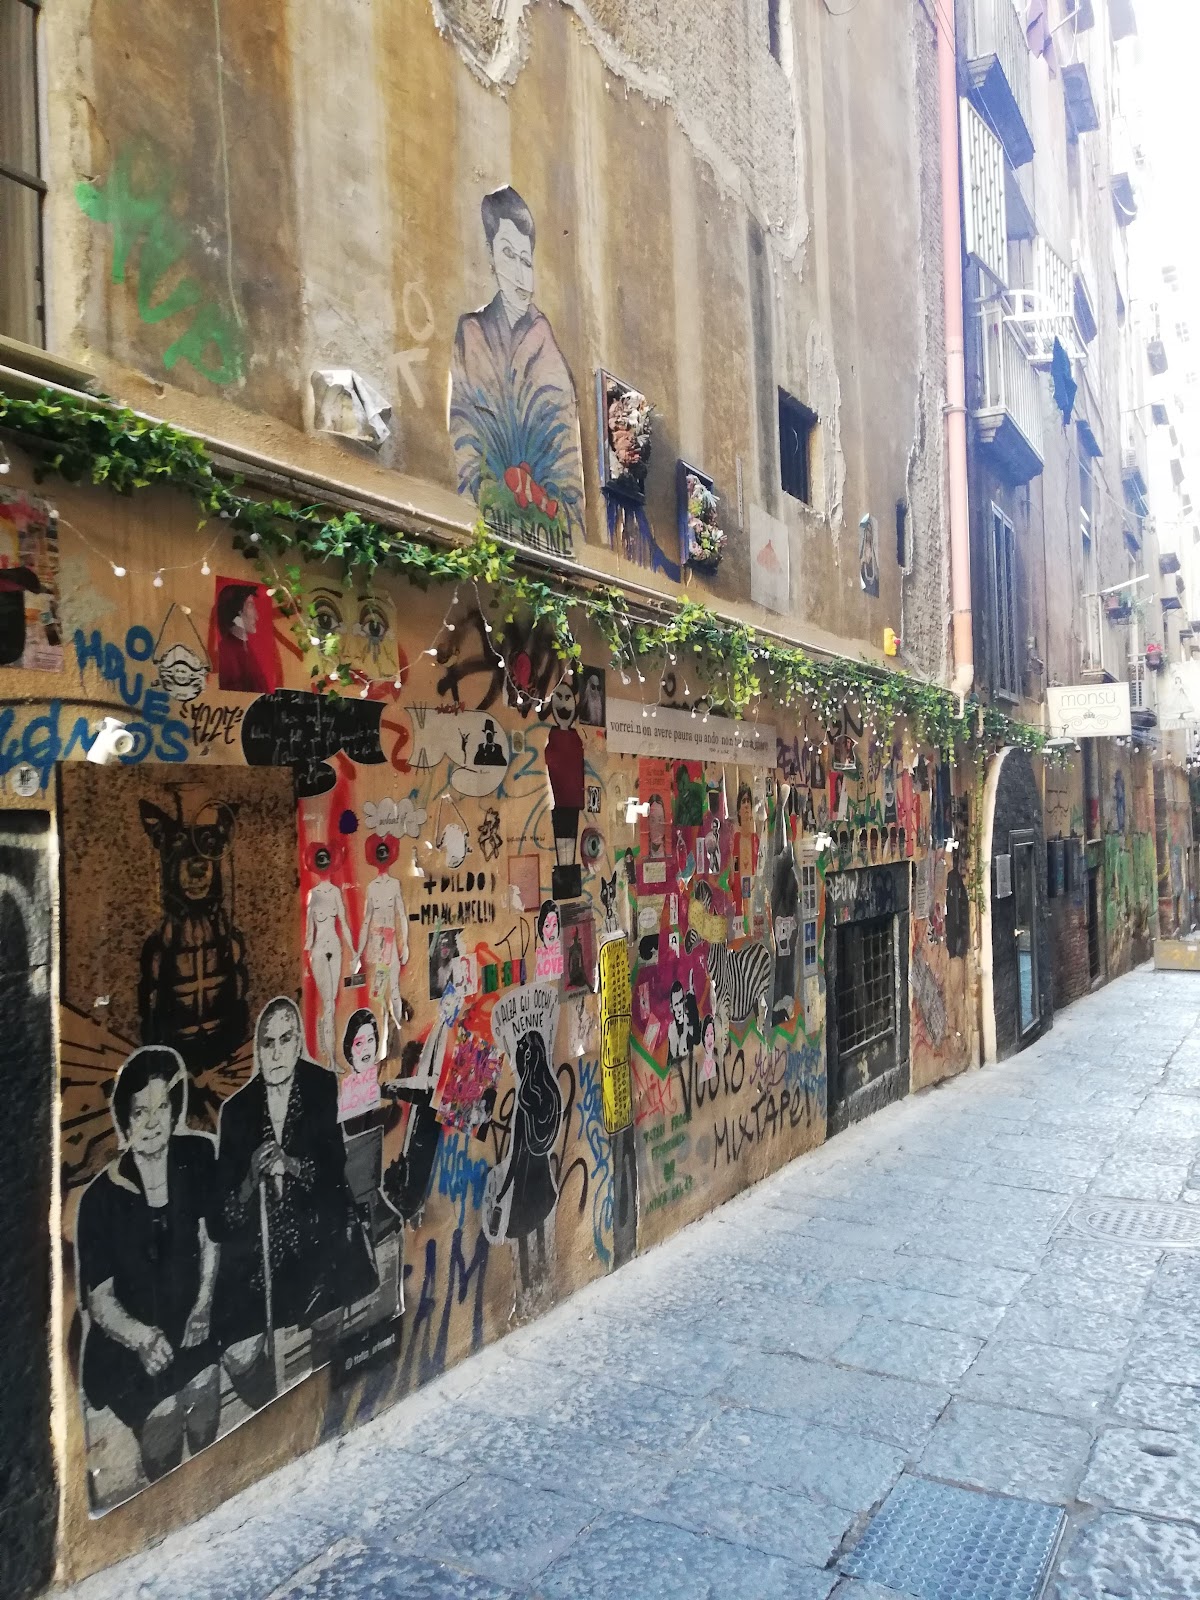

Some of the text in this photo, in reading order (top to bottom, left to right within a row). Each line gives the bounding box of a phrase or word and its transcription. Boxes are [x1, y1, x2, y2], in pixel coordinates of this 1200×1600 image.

[654, 727, 673, 739] avere
[673, 729, 693, 743] paura
[537, 956, 564, 976] LOVE
